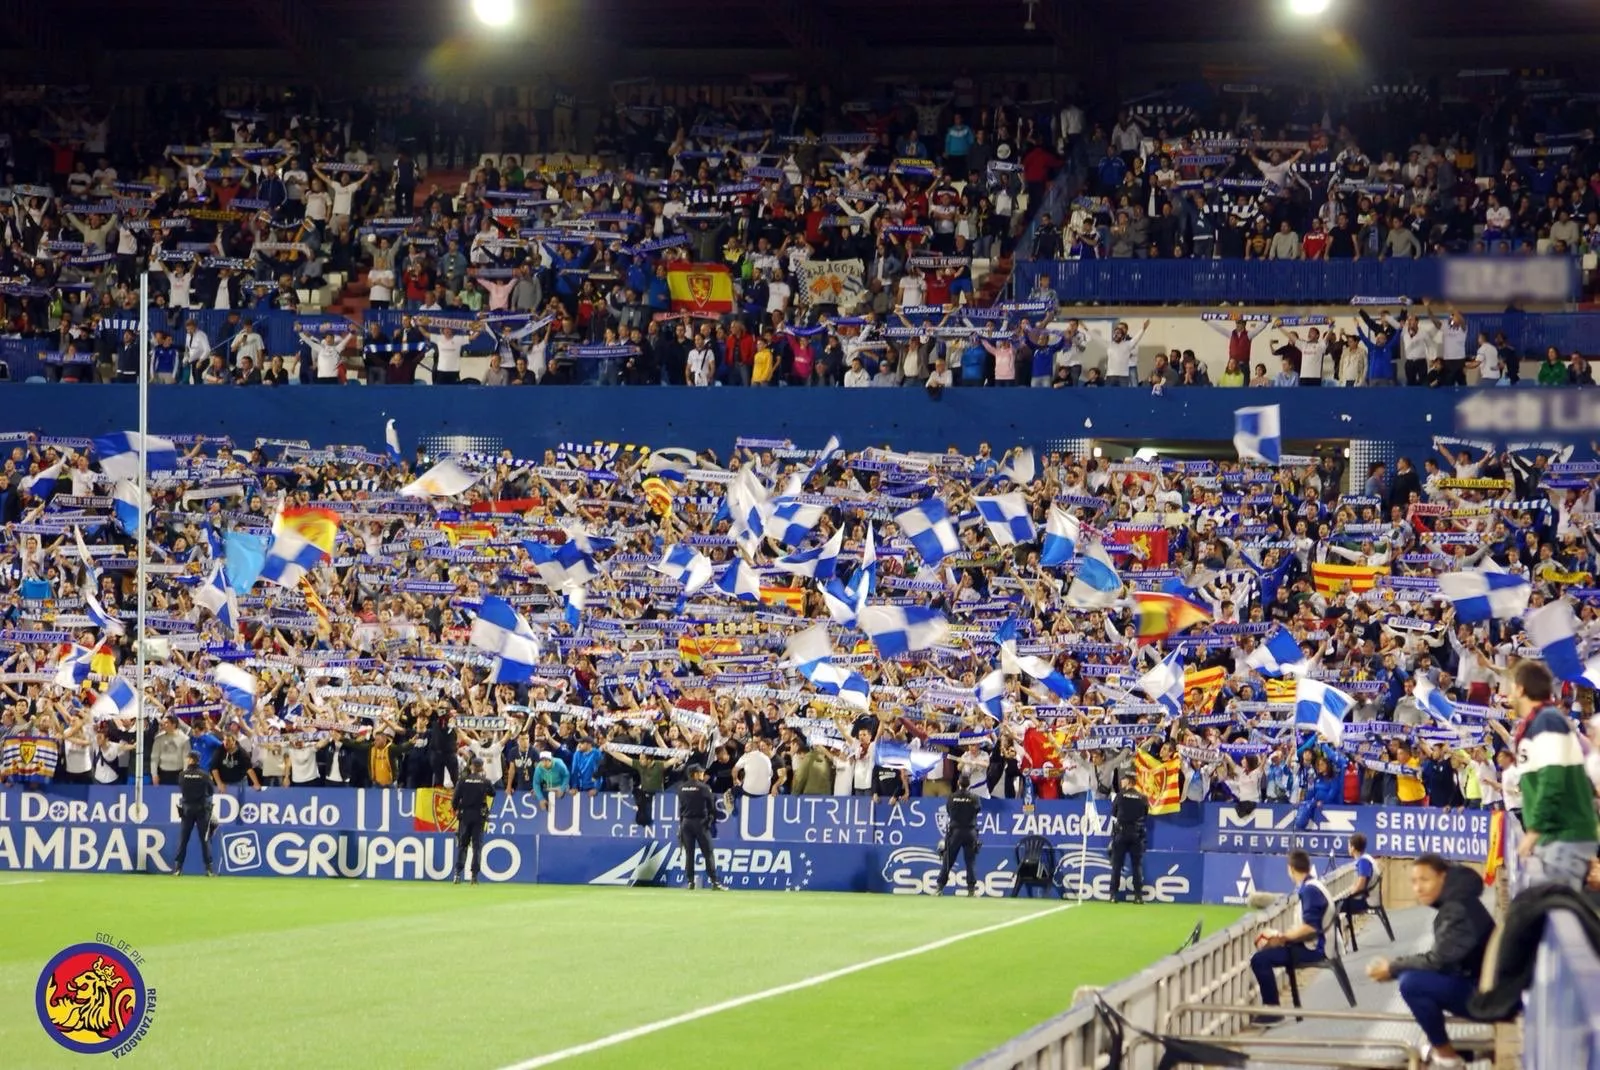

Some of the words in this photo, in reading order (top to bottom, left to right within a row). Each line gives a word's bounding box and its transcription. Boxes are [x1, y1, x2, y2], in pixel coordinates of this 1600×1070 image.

[1094, 727, 1150, 738] LIGALLO
[783, 797, 927, 827] UTRILLAS
[1376, 811, 1467, 833] SERVICIO
[1472, 816, 1488, 834] DE
[977, 812, 1008, 837] EAL
[0, 825, 173, 872] AMBAR
[805, 830, 904, 846] CENTRO
[1219, 834, 1349, 850] PREVENCIÓ
[1376, 833, 1488, 857] PREVENCIÓN
[666, 847, 794, 874] AGREDA
